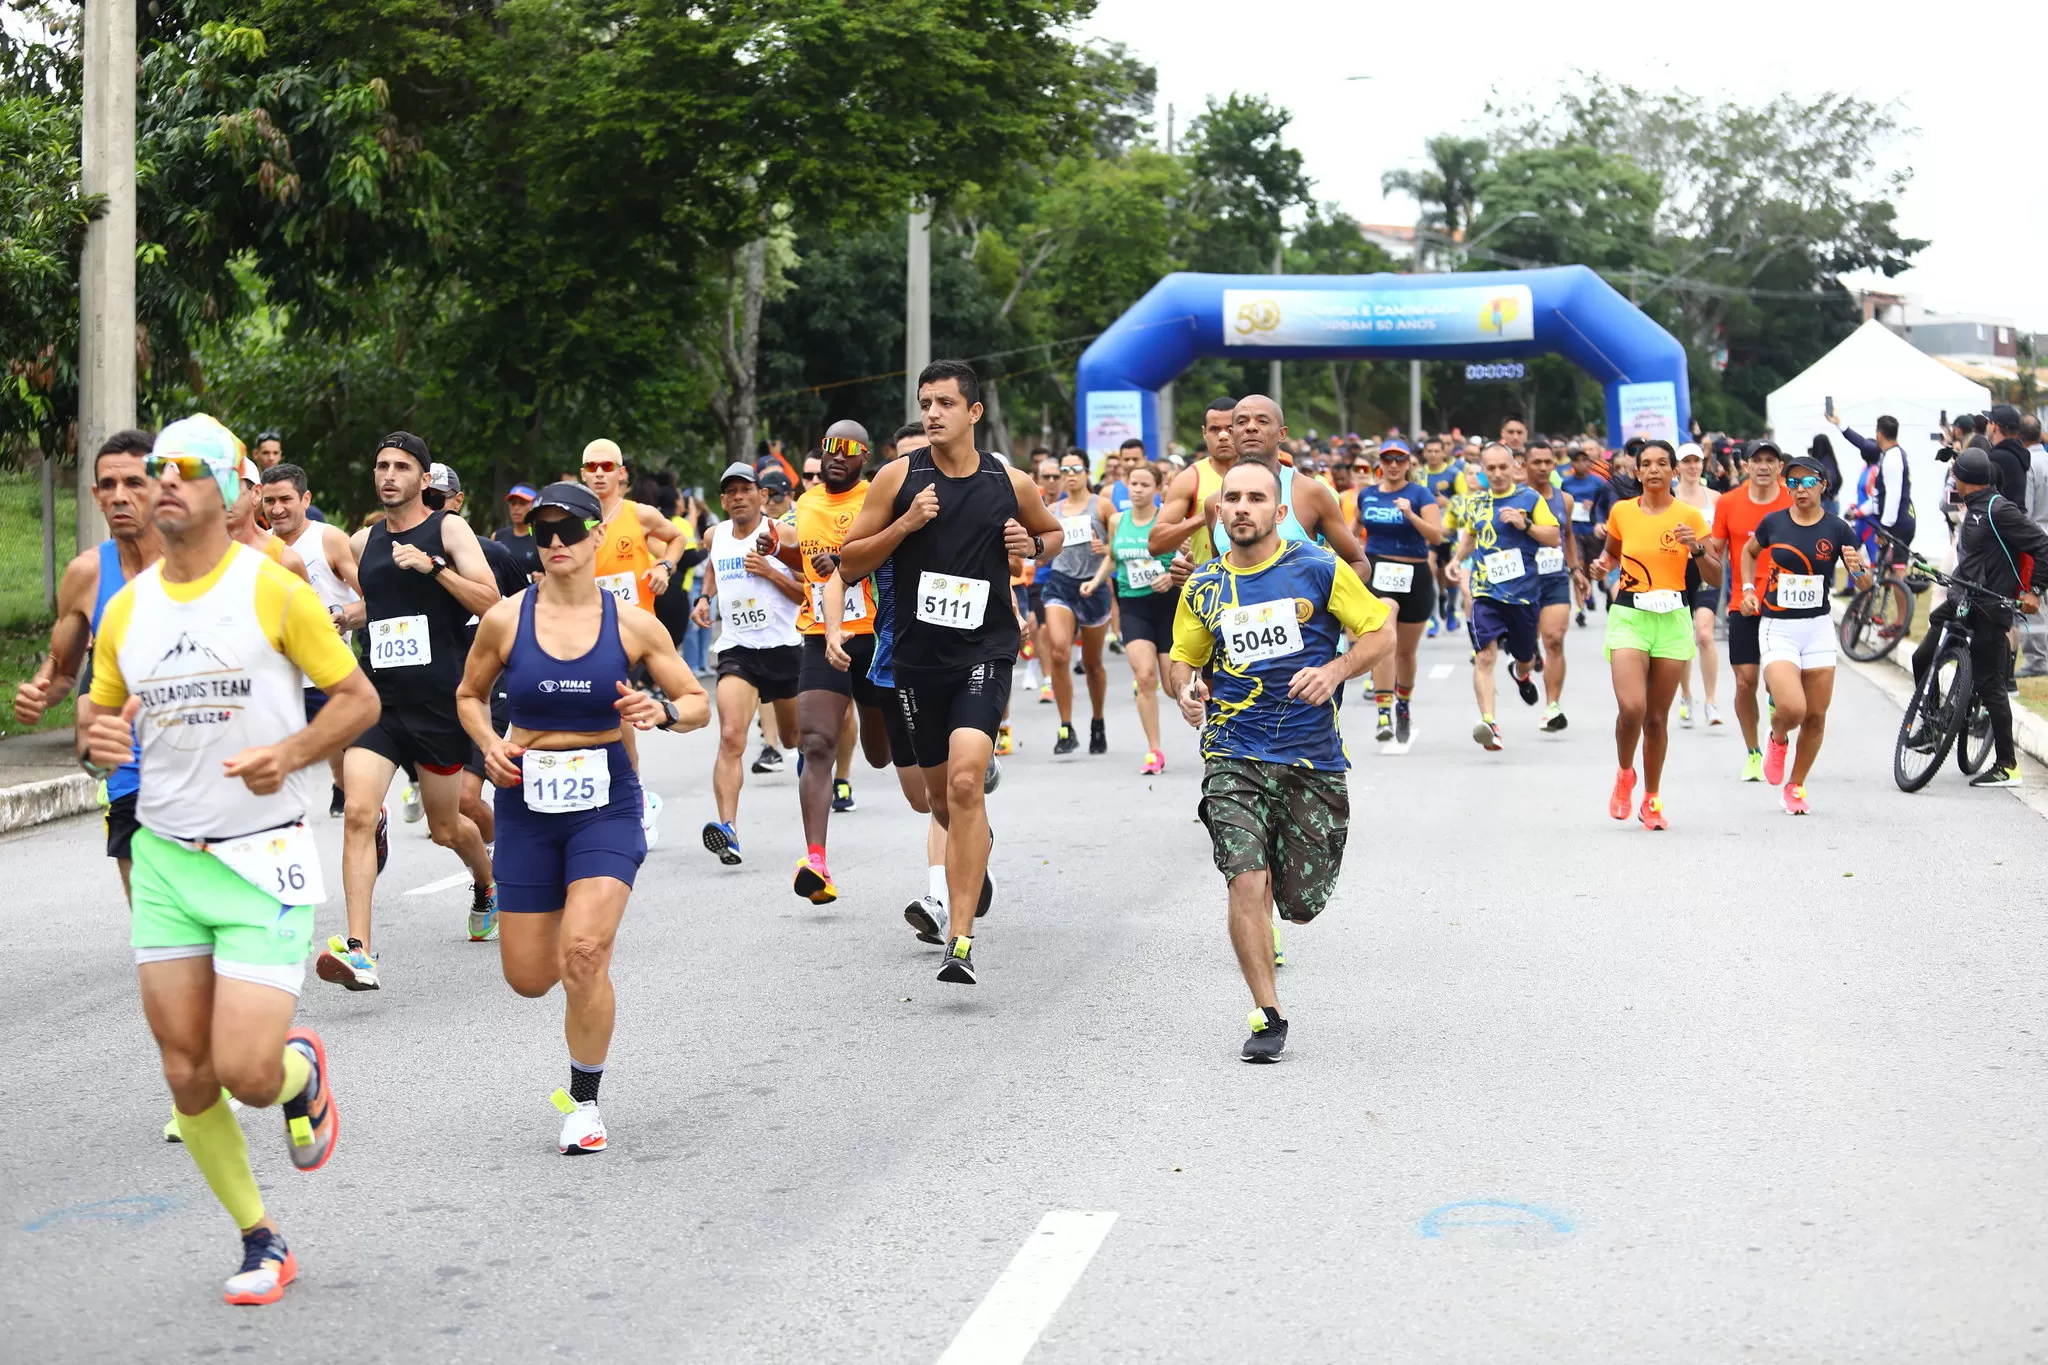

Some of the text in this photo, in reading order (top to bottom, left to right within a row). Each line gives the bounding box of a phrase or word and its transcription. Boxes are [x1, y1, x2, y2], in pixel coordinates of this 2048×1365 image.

[1783, 589, 1816, 603] 1108
[732, 609, 767, 626] 5165
[925, 595, 971, 620] 5111
[376, 638, 419, 660] 1033
[1232, 625, 1288, 654] 5048
[211, 678, 251, 697] TEAM
[559, 680, 592, 689] VINAC
[533, 777, 595, 801] 1125
